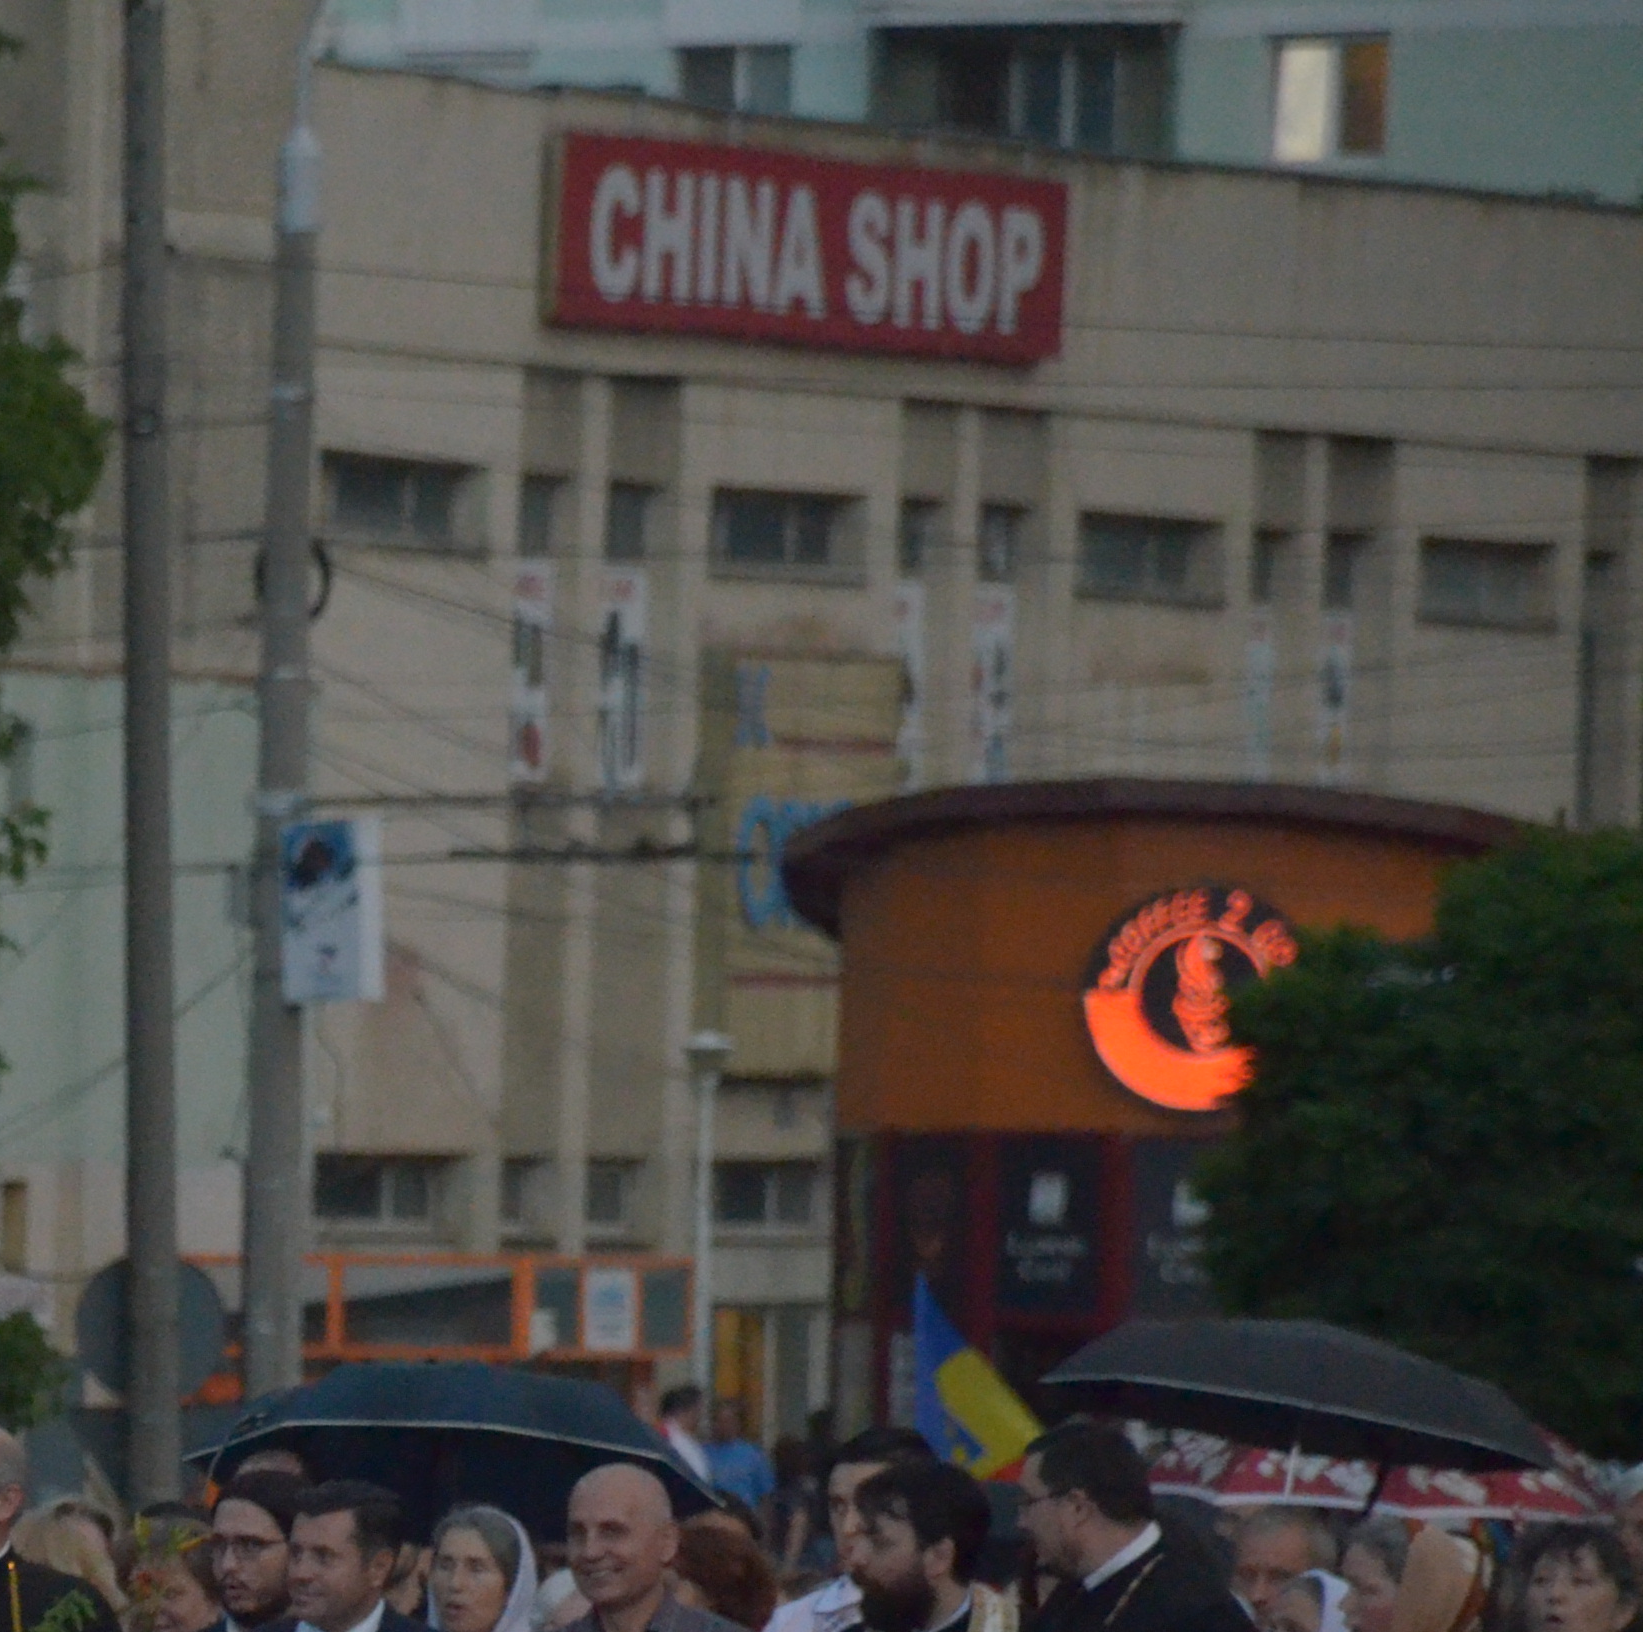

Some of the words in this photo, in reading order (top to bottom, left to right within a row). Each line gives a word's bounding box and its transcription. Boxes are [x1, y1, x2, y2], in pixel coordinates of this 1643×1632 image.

[590, 163, 827, 319] CHINA
[847, 191, 1046, 335] SHOP
[1218, 888, 1253, 932] 2
